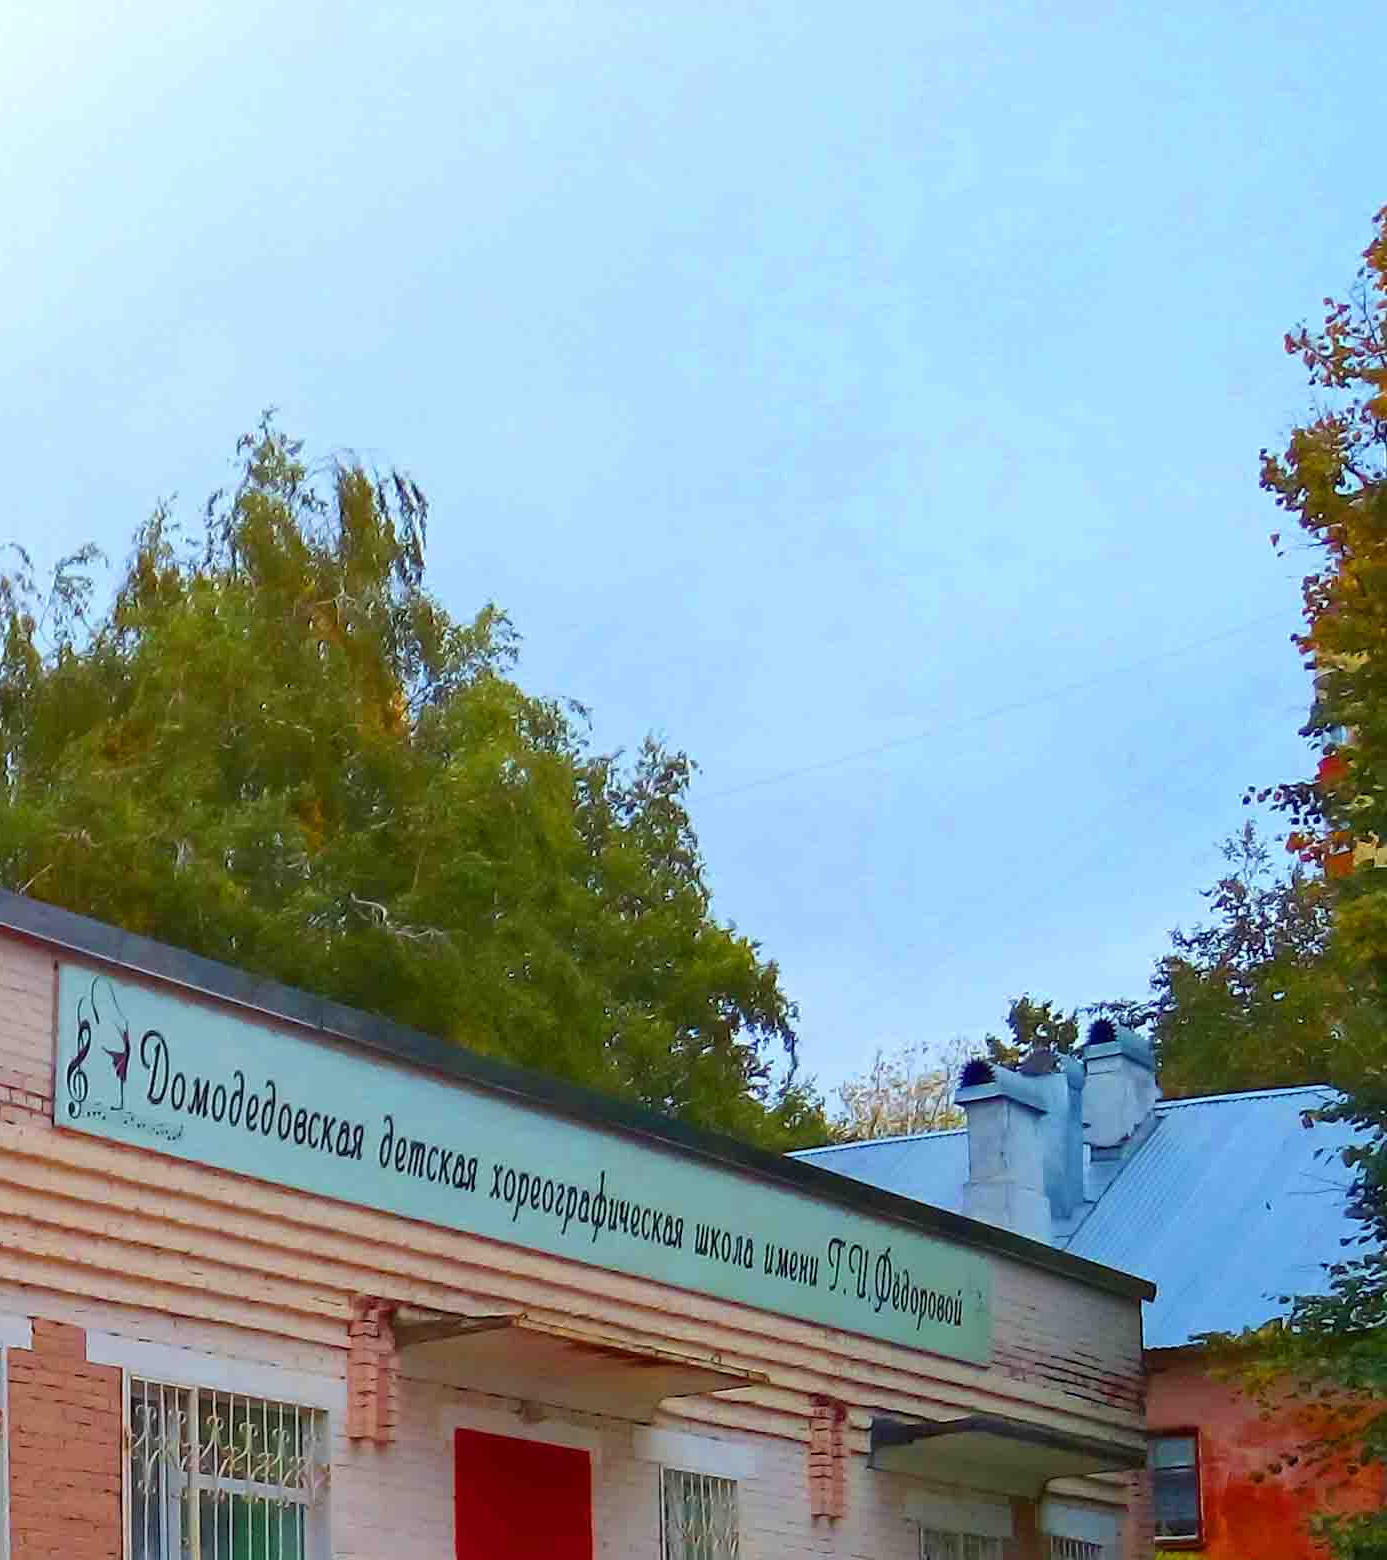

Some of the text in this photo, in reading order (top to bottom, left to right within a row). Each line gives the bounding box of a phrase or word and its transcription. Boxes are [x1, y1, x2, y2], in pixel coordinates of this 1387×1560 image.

[139, 1029, 365, 1161] Домодедовская
[378, 1114, 478, 1193] детская
[489, 1164, 685, 1249] хореографическая
[693, 1222, 754, 1270] школа
[763, 1242, 820, 1288] имени
